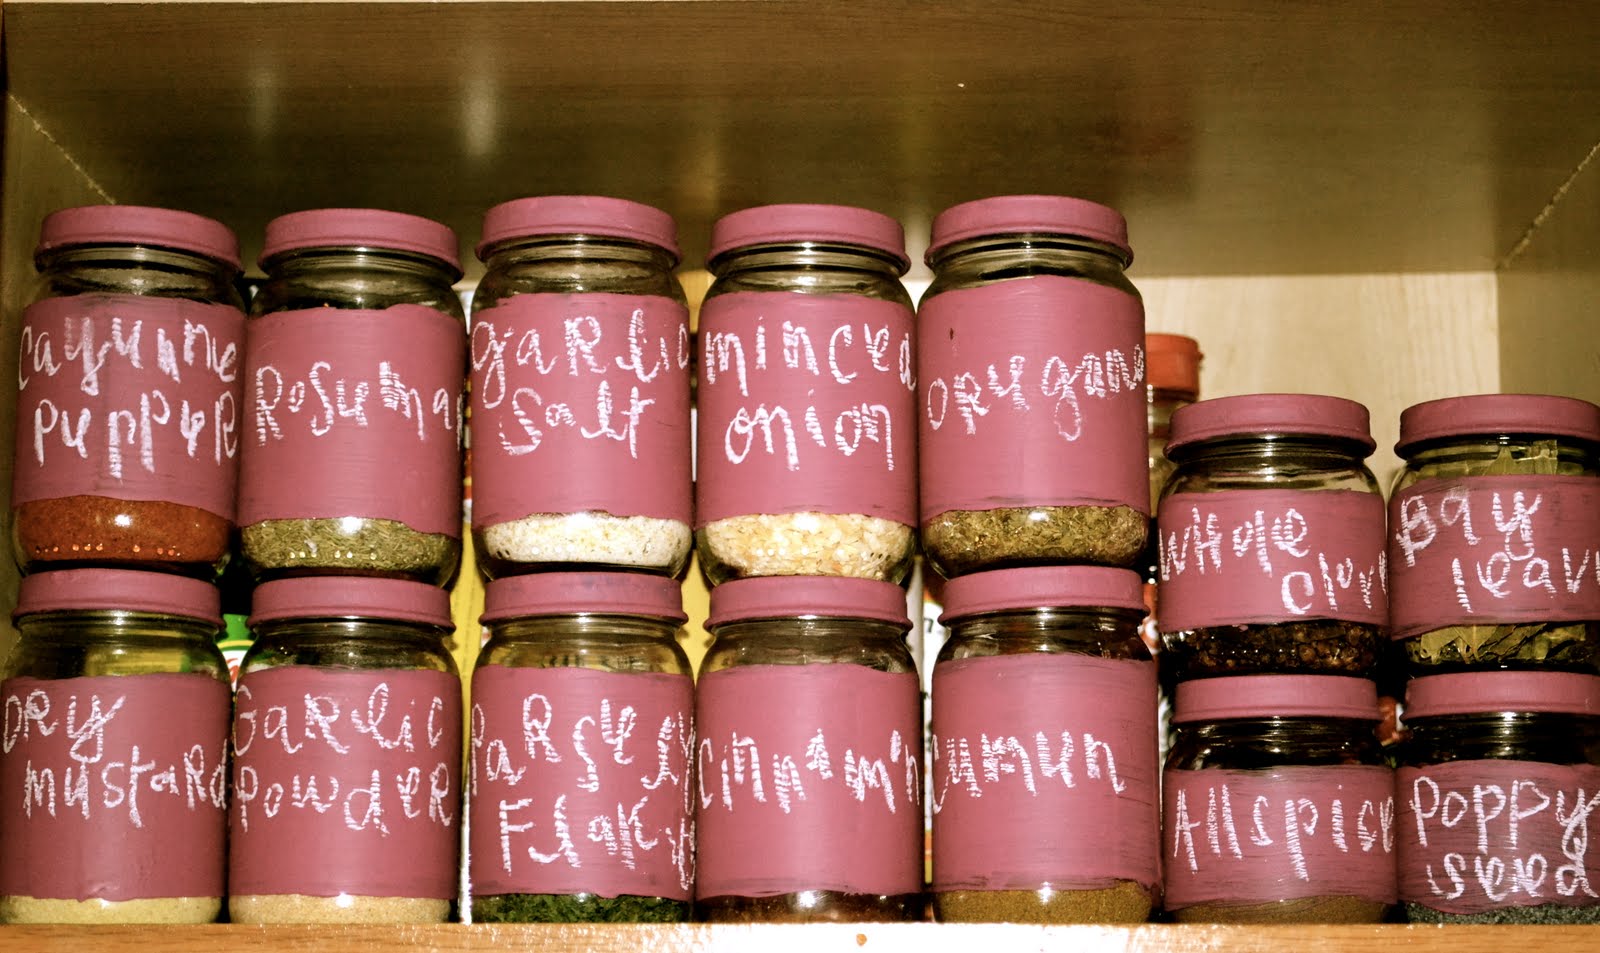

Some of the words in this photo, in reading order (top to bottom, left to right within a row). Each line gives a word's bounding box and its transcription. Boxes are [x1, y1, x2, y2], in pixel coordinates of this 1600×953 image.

[705, 316, 918, 397] minced
[724, 388, 895, 472] onion
[1396, 487, 1543, 568] Bay
